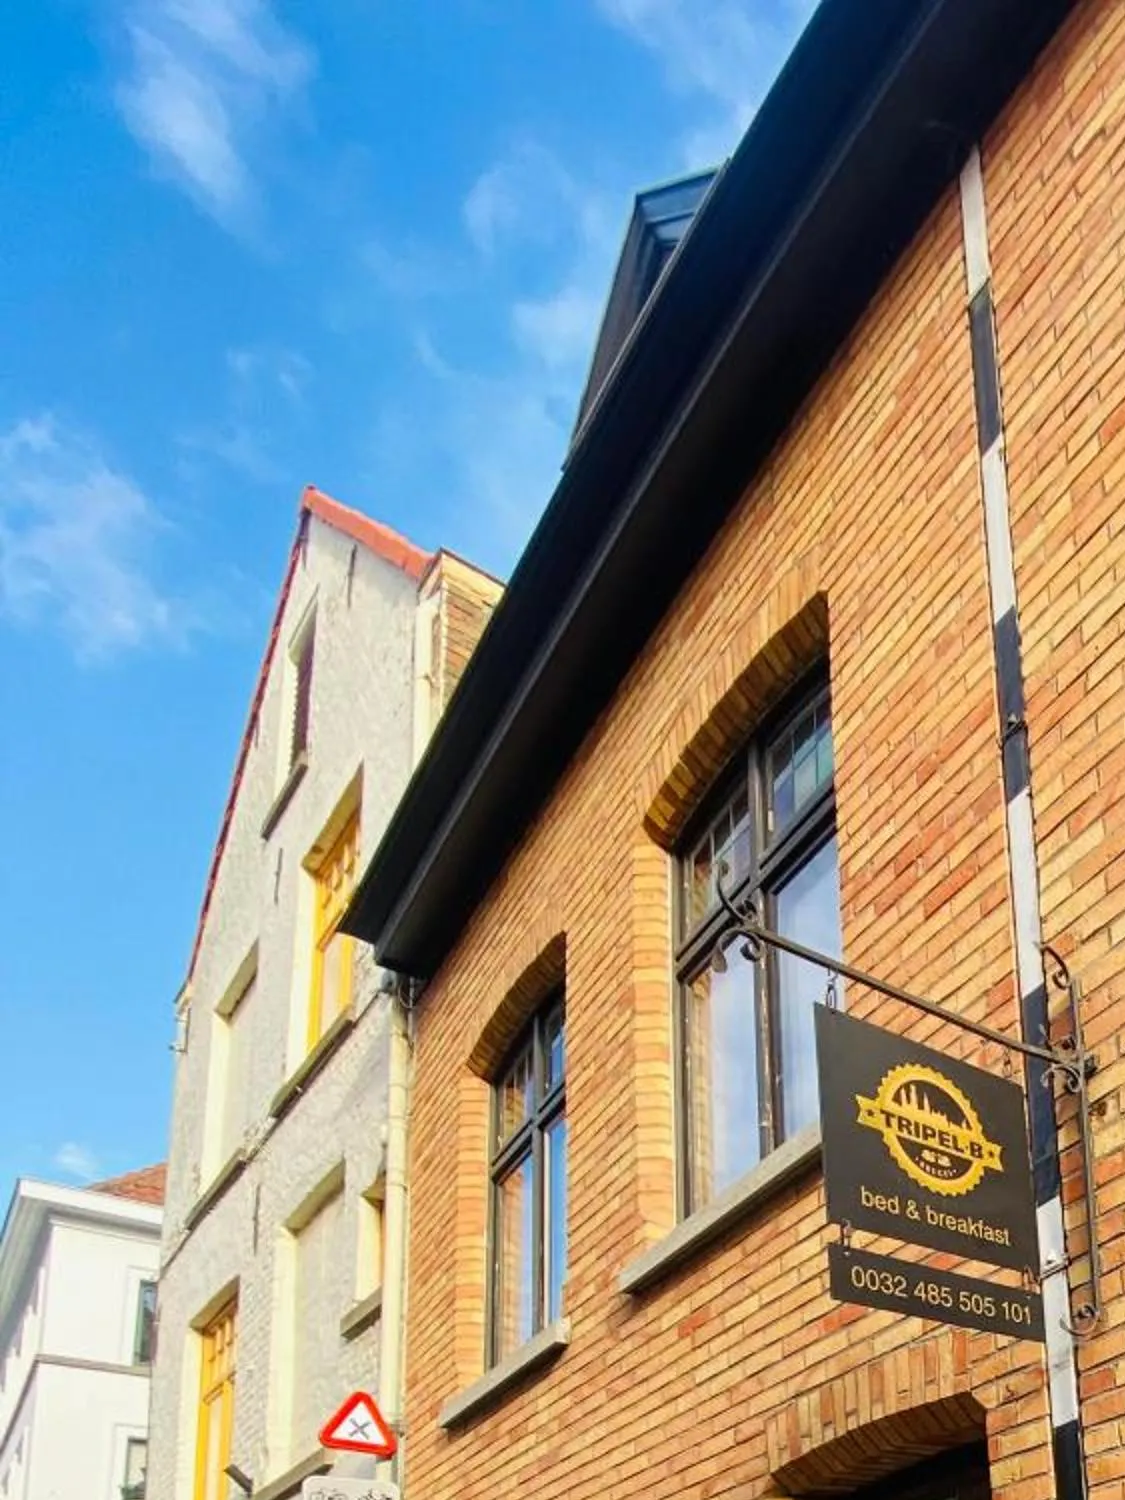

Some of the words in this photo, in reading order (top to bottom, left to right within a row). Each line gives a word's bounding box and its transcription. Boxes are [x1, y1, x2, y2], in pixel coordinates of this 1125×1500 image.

[861, 1185, 899, 1215] bed
[906, 1200, 921, 1222] &
[926, 1204, 1011, 1246] breakfast
[851, 1265, 907, 1298] 0032
[913, 1281, 953, 1309] 485
[959, 1291, 996, 1318] 505
[1002, 1301, 1031, 1325] 101
